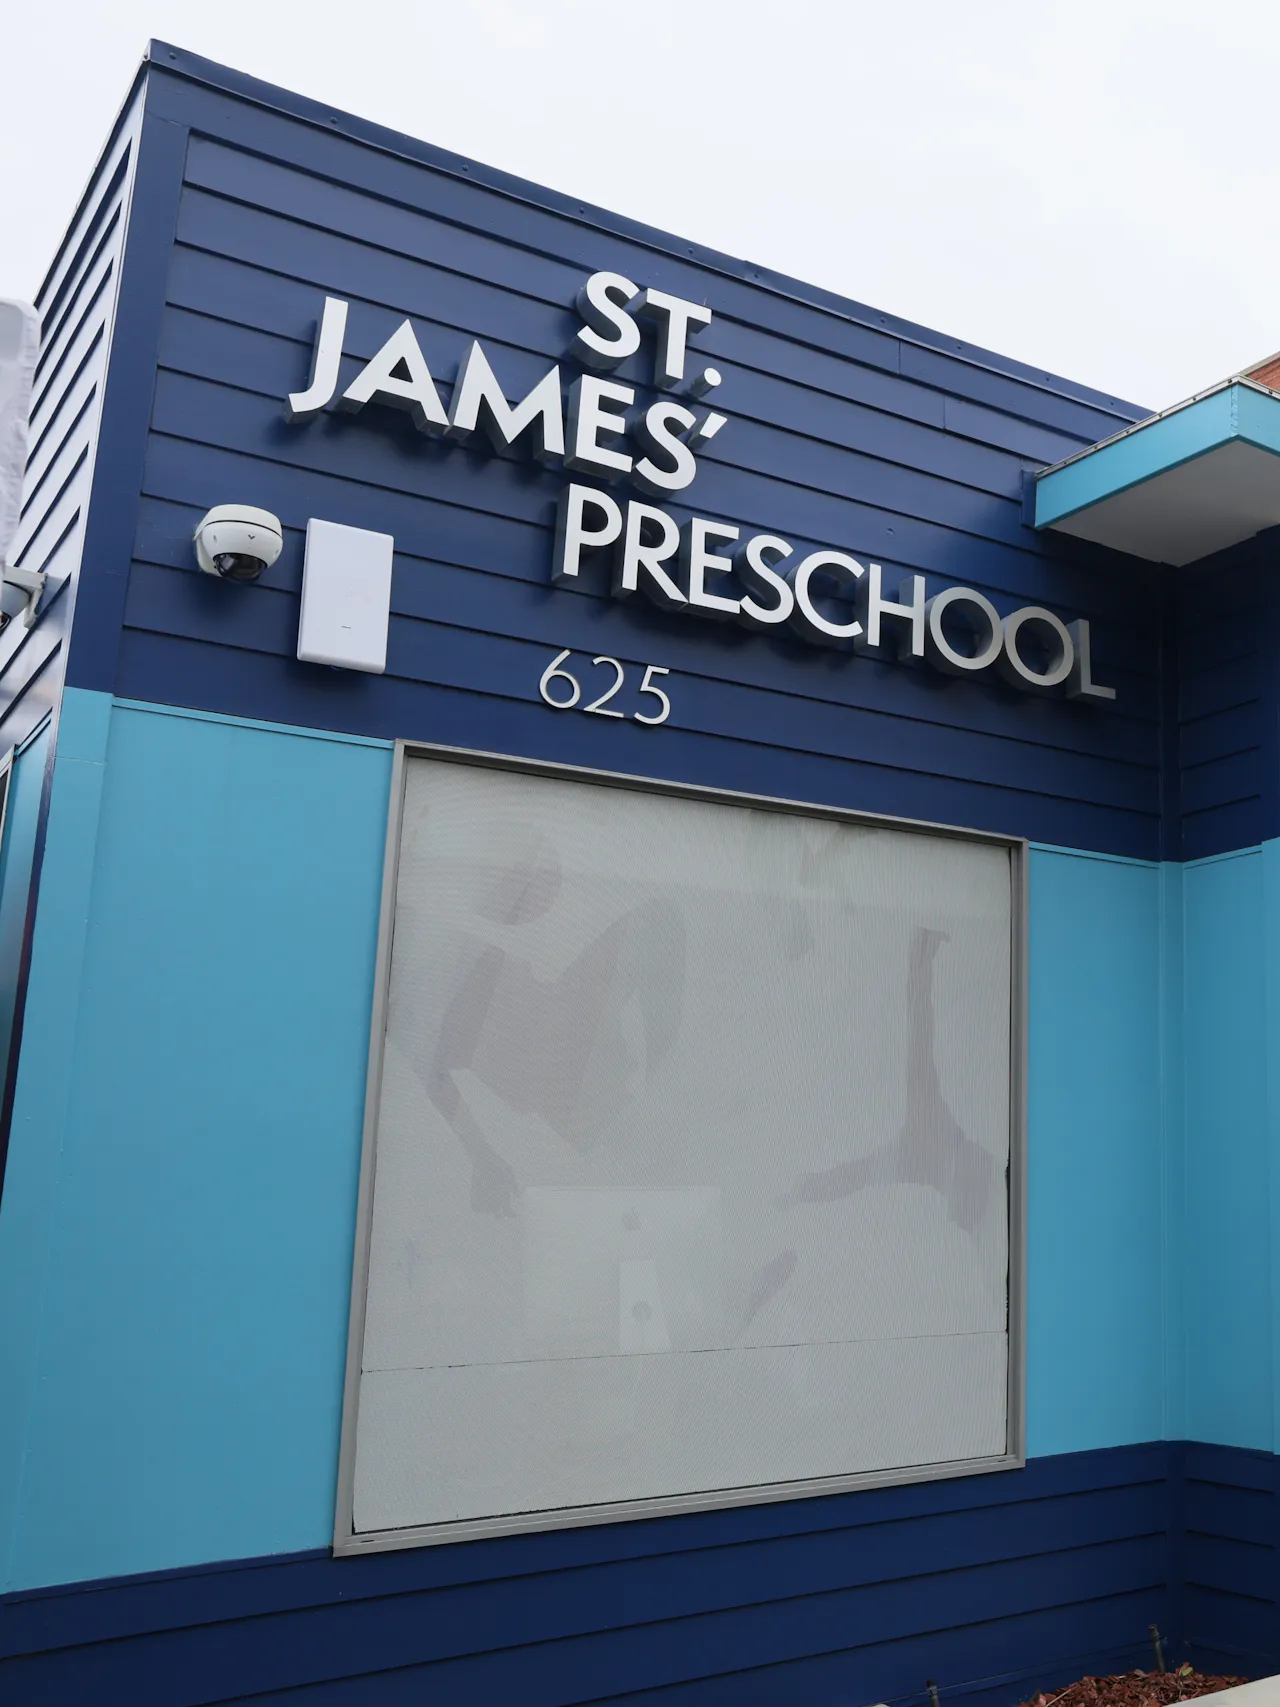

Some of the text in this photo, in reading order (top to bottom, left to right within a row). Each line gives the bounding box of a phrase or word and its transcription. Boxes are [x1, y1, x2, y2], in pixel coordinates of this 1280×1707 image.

[578, 271, 722, 387] ST.
[562, 483, 1116, 701] PRESCHOOL
[539, 649, 671, 726] 625
